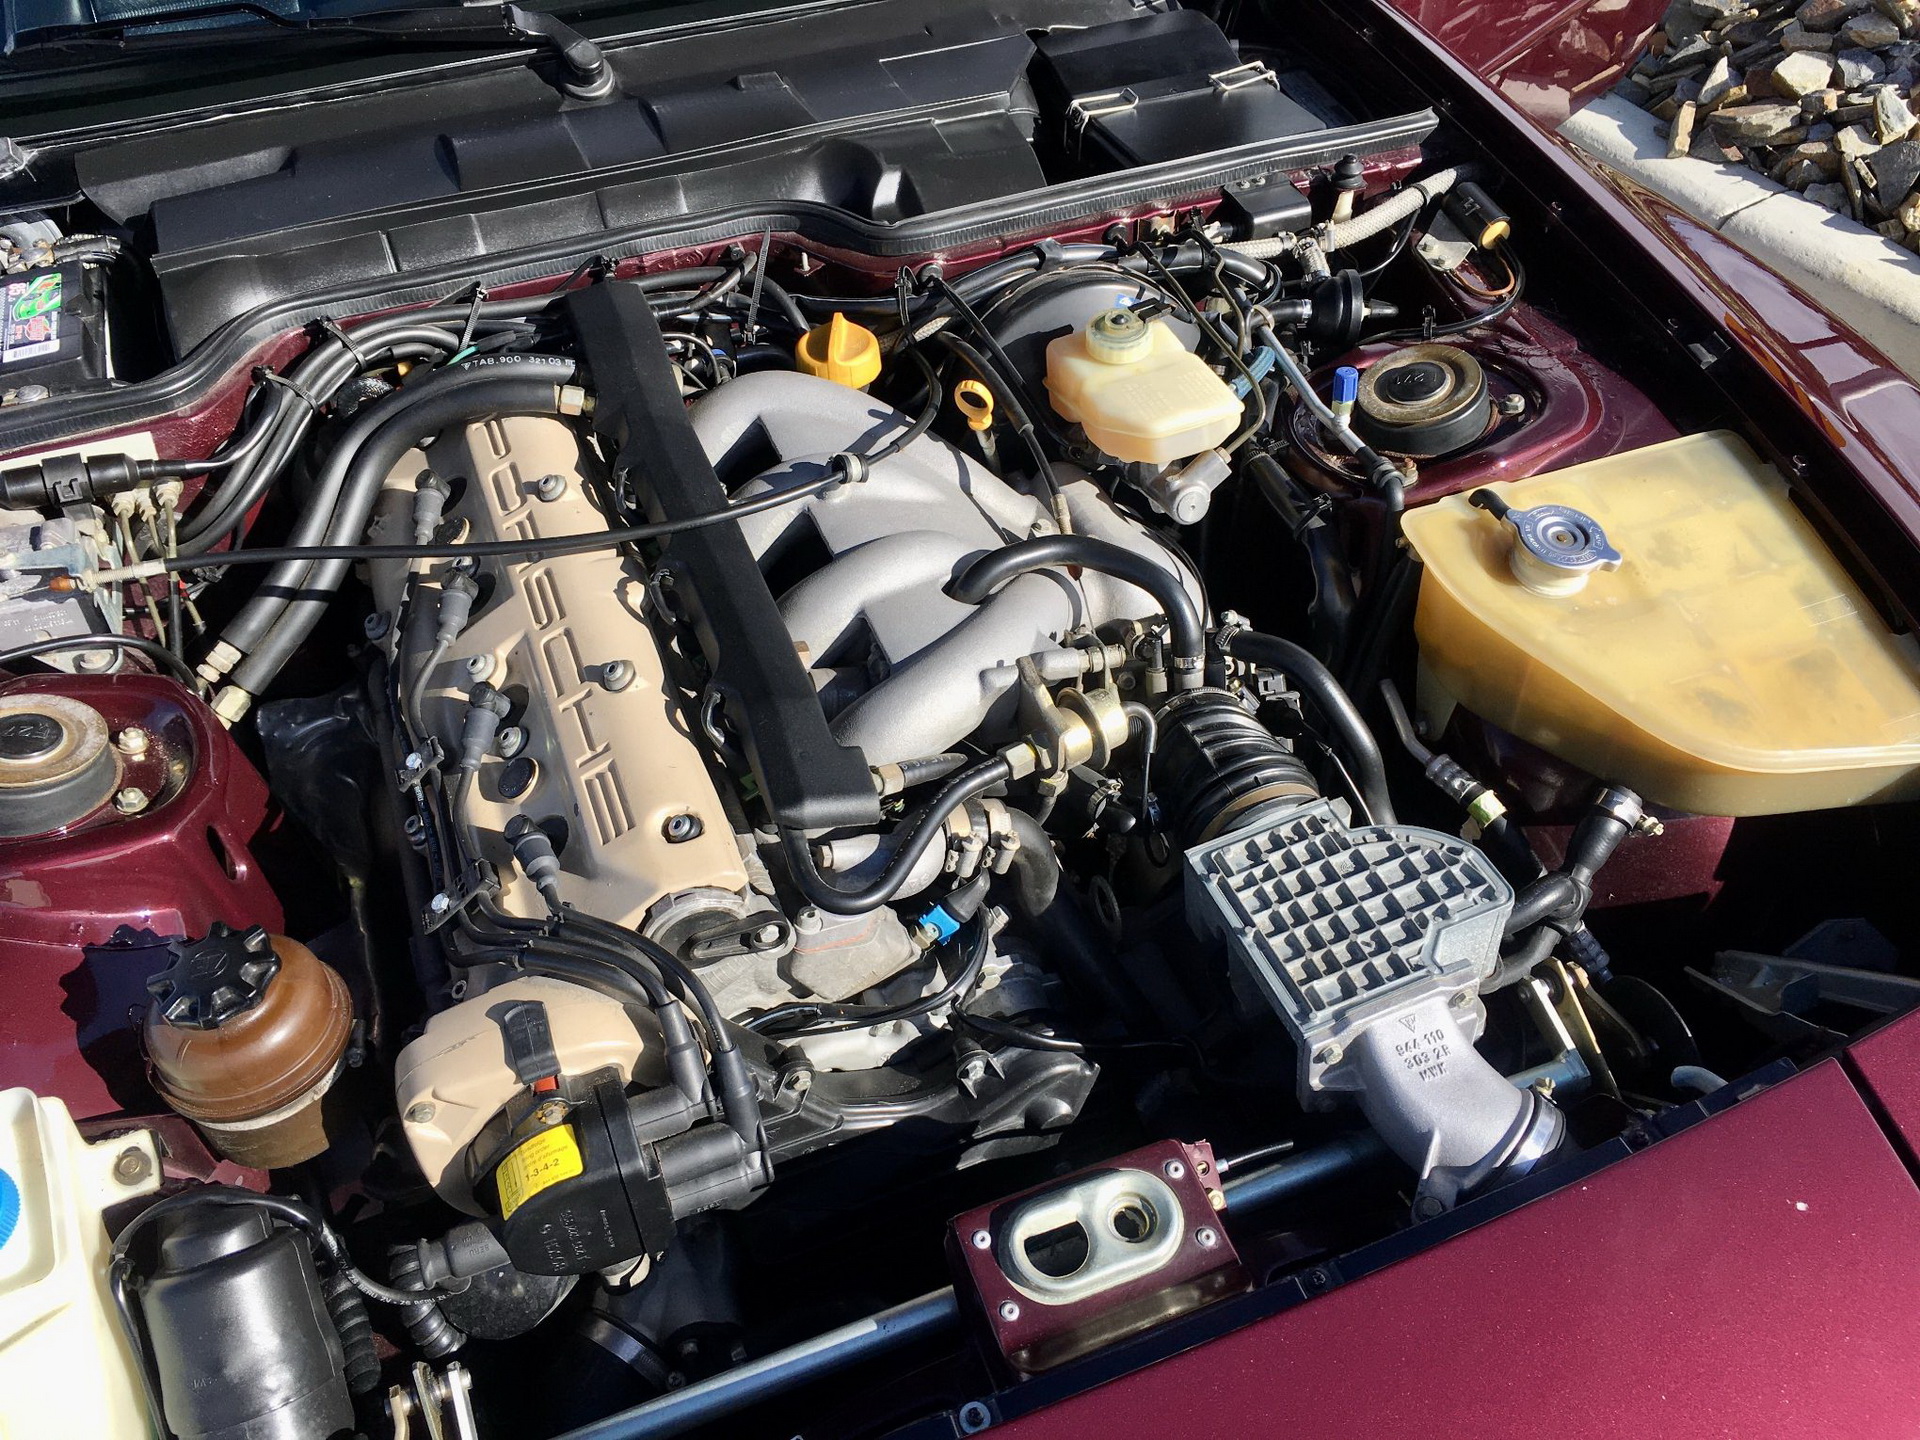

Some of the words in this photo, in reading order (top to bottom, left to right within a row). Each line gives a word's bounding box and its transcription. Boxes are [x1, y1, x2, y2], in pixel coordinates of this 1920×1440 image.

[548, 357, 561, 367] 03
[472, 414, 637, 846] PORSCHE
[1423, 1028, 1445, 1045] 110
[525, 1157, 560, 1182] 1-3-4-2
[357, 1282, 378, 1299] BERU
